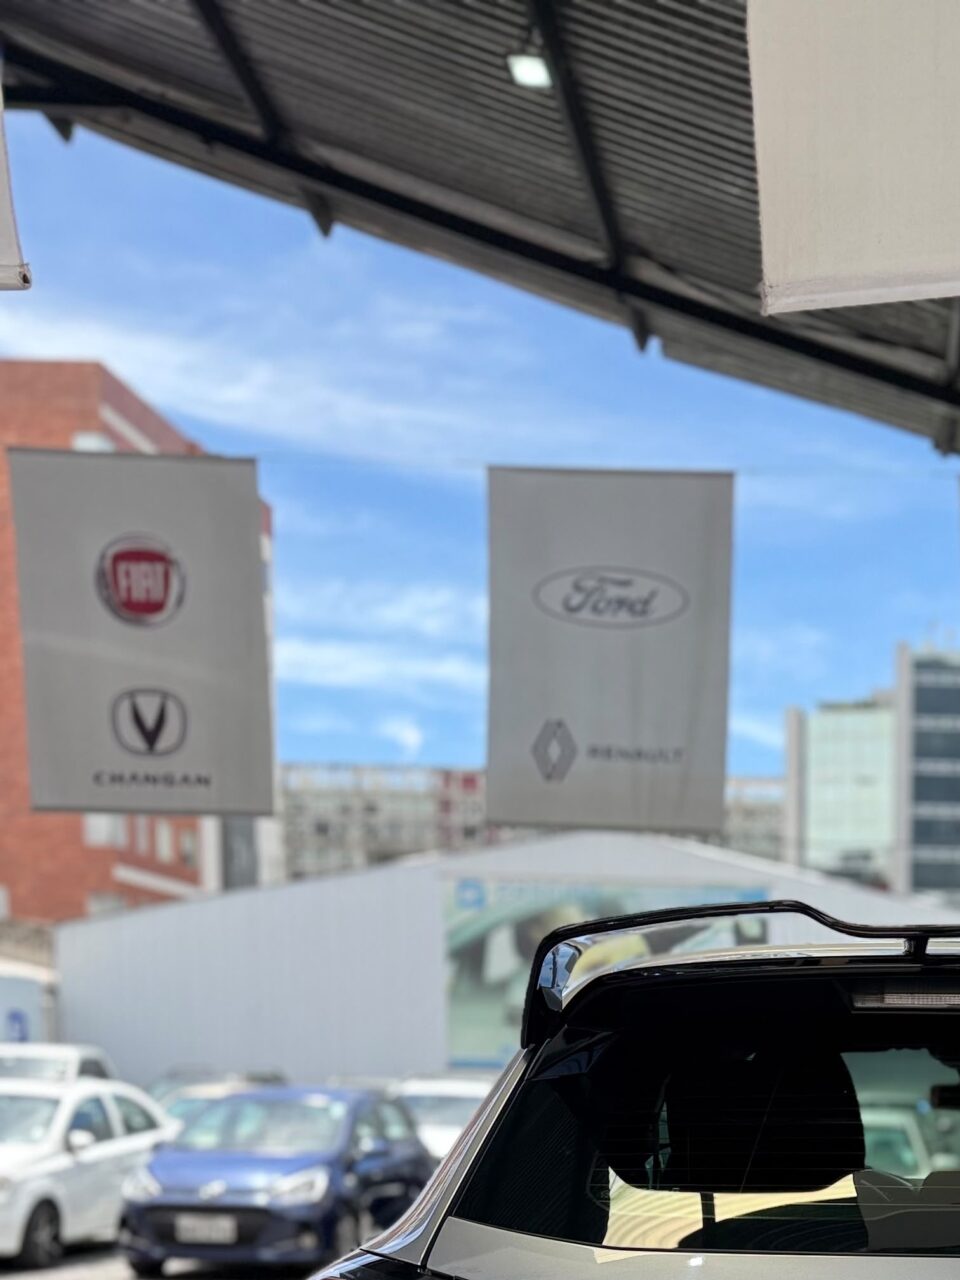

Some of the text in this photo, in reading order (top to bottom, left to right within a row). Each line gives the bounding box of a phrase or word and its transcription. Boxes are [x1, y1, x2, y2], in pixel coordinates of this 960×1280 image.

[116, 560, 168, 604] FIAT
[562, 577, 659, 617] Ford
[93, 771, 212, 788] CHANGAN
